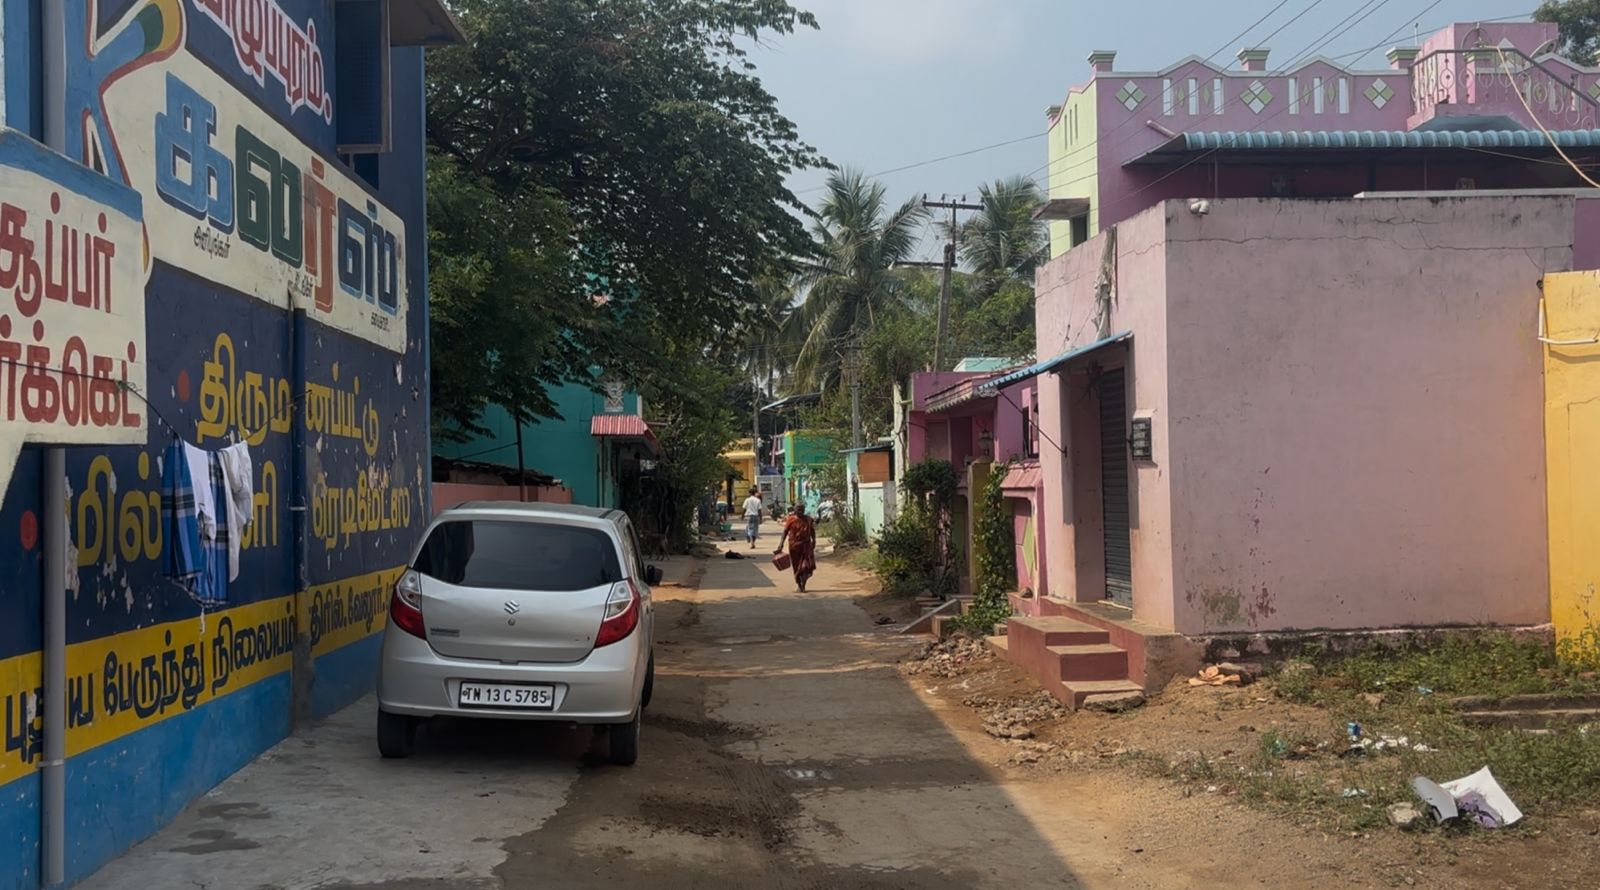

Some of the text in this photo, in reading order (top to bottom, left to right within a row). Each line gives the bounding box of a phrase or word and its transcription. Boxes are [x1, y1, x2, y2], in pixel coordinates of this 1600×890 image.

[103, 629, 205, 719] பேருந்து
[212, 601, 297, 696] நிலையம்
[466, 687, 547, 704] TN 13 C 5785
